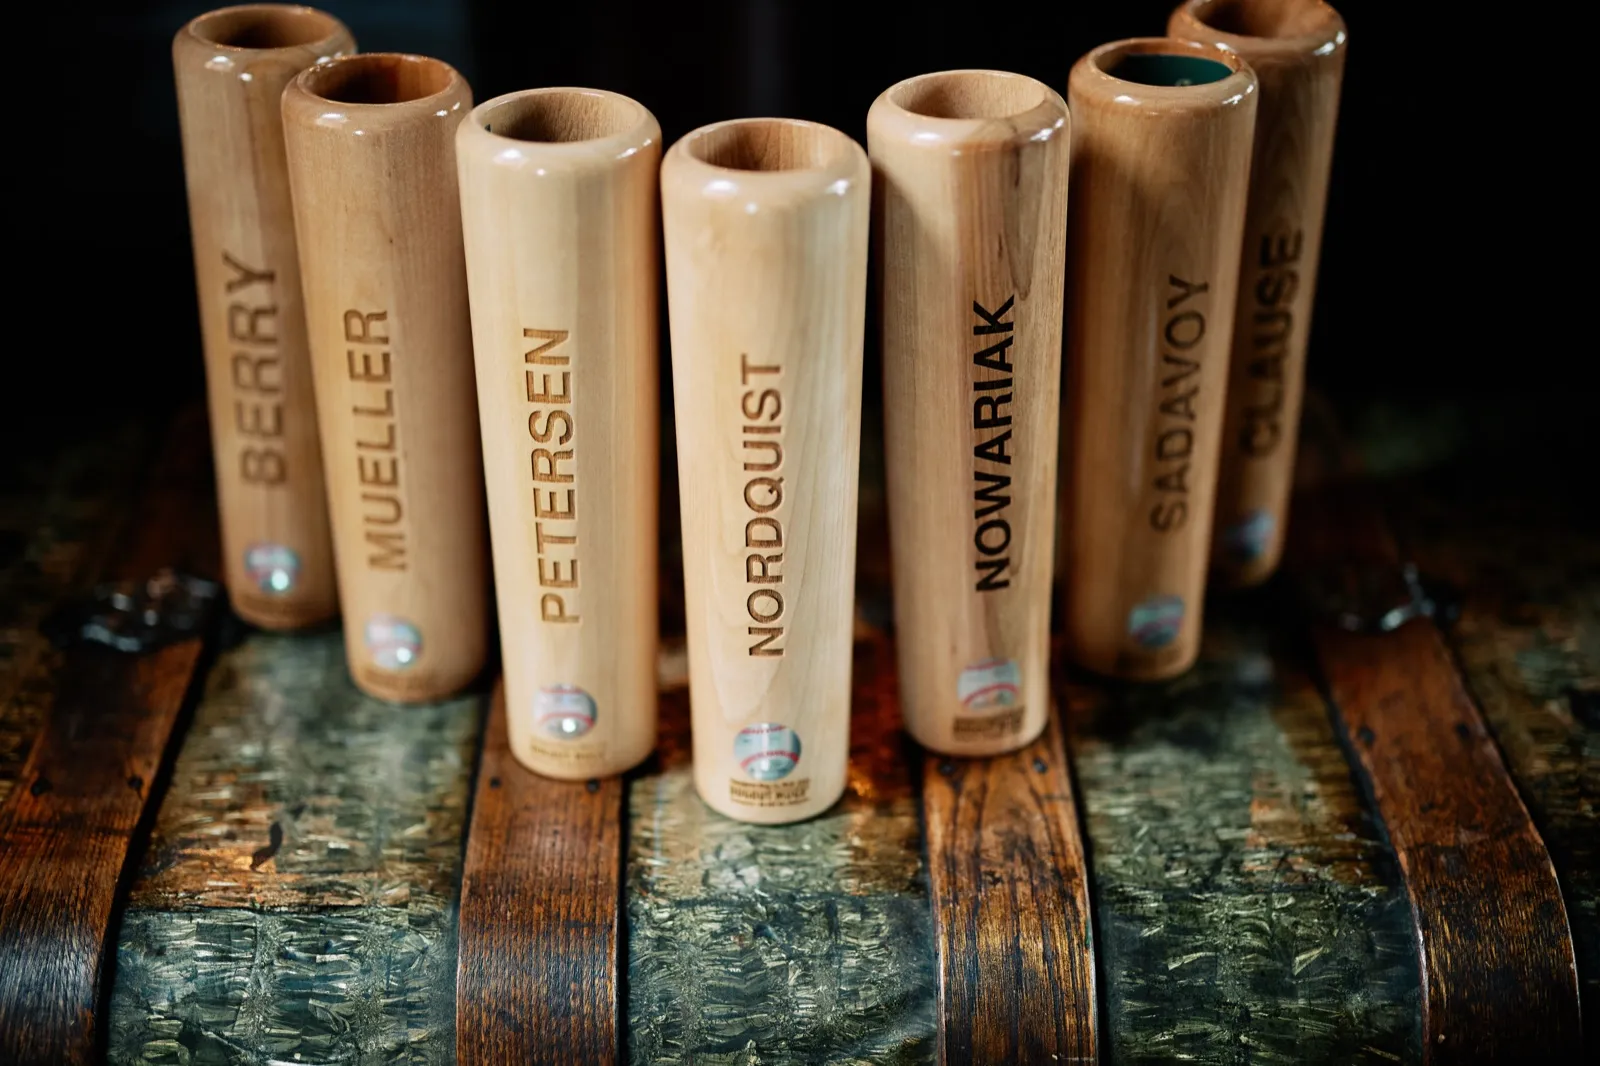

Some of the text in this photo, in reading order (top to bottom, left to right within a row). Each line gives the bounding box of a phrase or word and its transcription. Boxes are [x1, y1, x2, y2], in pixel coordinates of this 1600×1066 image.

[221, 251, 286, 487] BERRY
[343, 308, 407, 572] MUELLER
[523, 327, 581, 624] PETERSEN
[972, 295, 1015, 592] NOWARIAK
[1150, 274, 1209, 533] SADAVOY
[1239, 228, 1304, 462] CLAUSE
[740, 353, 785, 657] NORDQUIST
